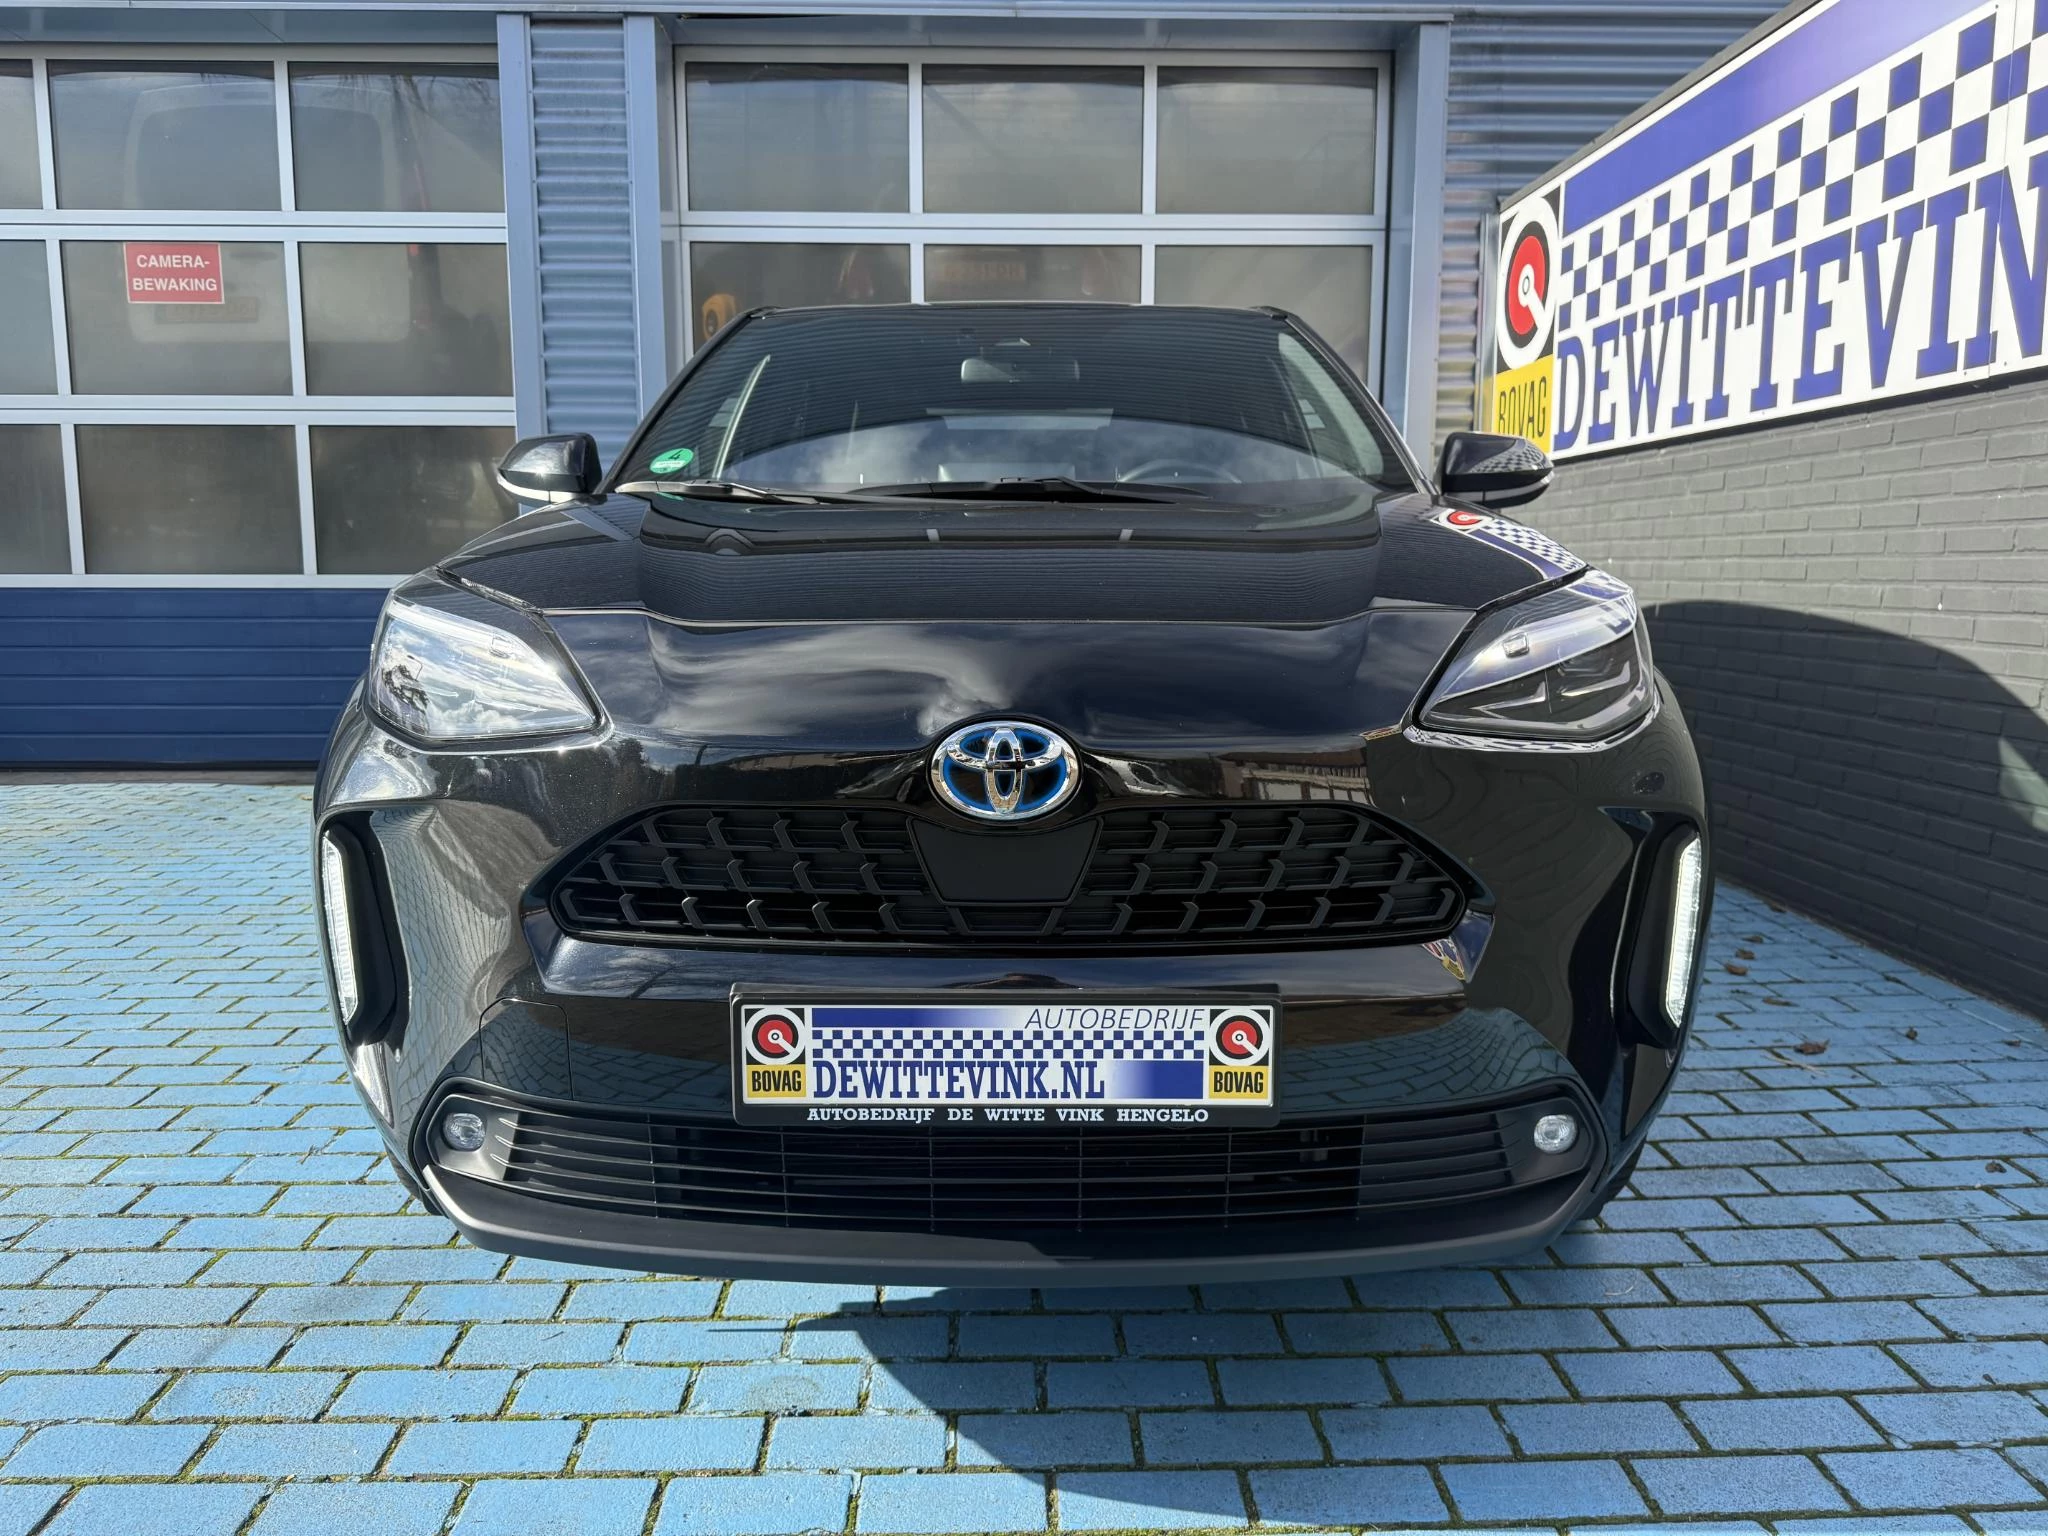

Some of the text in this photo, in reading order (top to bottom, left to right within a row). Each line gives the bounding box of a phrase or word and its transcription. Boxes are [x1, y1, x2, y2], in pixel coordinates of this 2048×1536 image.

[136, 254, 210, 269] CAMERA-
[132, 277, 217, 292] BEWAKING
[1024, 1008, 1205, 1029] AUTOBEDRIJF
[751, 1069, 802, 1092] BOVAG
[812, 1060, 1105, 1099] DEWITTEVINK.NL
[1213, 1071, 1264, 1093] BOVAG
[807, 1108, 1209, 1123] AUTOBEDRIJF DE WITTE VINK HENGELO
